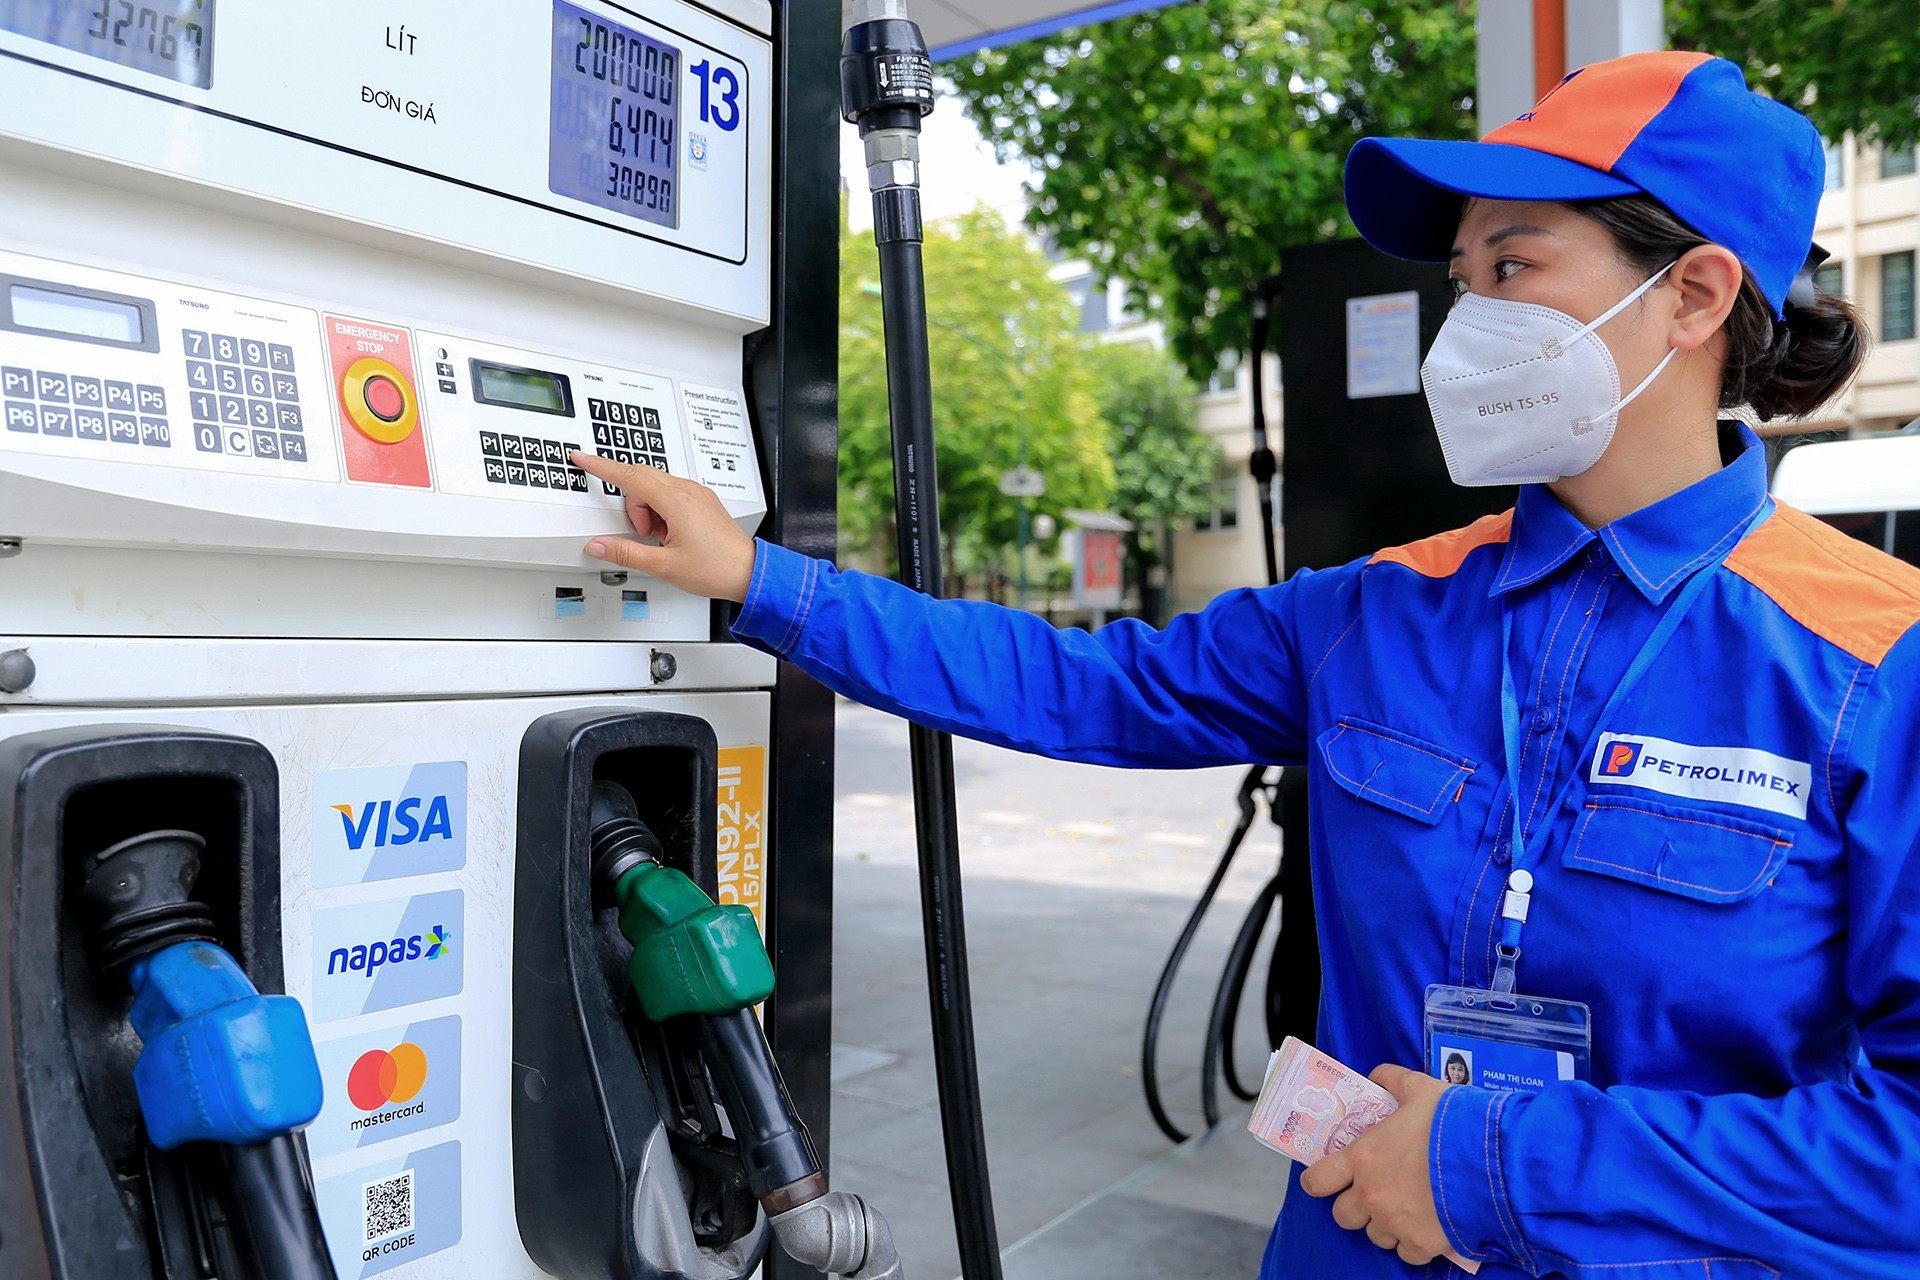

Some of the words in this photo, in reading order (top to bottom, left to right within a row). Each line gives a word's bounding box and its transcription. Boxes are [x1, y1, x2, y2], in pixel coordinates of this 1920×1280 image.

[386, 25, 417, 55] LÍT
[575, 17, 675, 106] 200000
[361, 85, 401, 113] ĐƠN
[405, 102, 436, 125] GIÁ
[689, 59, 740, 132] 13
[606, 161, 671, 214] 30890
[335, 323, 401, 345] EMERGENCY
[356, 340, 384, 355] STOP
[188, 333, 203, 354] 7
[219, 339, 233, 359] 8
[247, 343, 261, 364] 9
[273, 351, 289, 366] F1
[5, 373, 29, 393] P1
[41, 378, 67, 398] P2
[75, 383, 100, 401] P3
[108, 387, 133, 405] P4
[141, 391, 164, 409] P5
[193, 365, 208, 386] 4
[223, 369, 237, 391] 5
[251, 374, 265, 395] 6
[276, 380, 295, 396] F2
[197, 396, 209, 418] 1
[226, 400, 241, 422] 2
[254, 404, 269, 425] 3
[280, 410, 299, 426] F3
[684, 389, 705, 400] Preset
[705, 393, 739, 406] Instruction
[1478, 400, 1514, 417] BUSH
[1517, 391, 1559, 411] TS-95
[9, 407, 35, 428] P6
[44, 412, 70, 432] P7
[78, 416, 103, 436] P8
[112, 420, 136, 439] P9
[142, 423, 169, 443] P10
[591, 400, 602, 418] 7
[611, 404, 622, 421] 8
[629, 407, 639, 424] 9
[646, 412, 658, 425] F1
[200, 428, 215, 450] 0
[229, 431, 246, 453] C
[284, 440, 303, 456] F4
[483, 437, 498, 451] P1
[504, 440, 521, 454] P2
[525, 443, 541, 457] P3
[545, 446, 562, 460] P4
[597, 426, 607, 443] 4
[615, 429, 626, 446] 5
[633, 432, 644, 449] 6
[650, 436, 663, 449] F2
[907, 444, 915, 473] TATSUNO
[487, 464, 504, 479] P6
[508, 467, 524, 481] P7
[529, 470, 546, 484] P8
[550, 472, 566, 486] P9
[569, 473, 587, 488] P10
[912, 538, 920, 558] MADE
[914, 558, 921, 567] IN
[1641, 755, 1801, 798] PETROLIMEX
[329, 795, 453, 850] VISA
[327, 935, 422, 978] napas
[1521, 1076, 1544, 1087] LOAN
[350, 1101, 424, 1131] mastercard
[362, 1246, 380, 1262] QR
[382, 1233, 416, 1256] CODE
